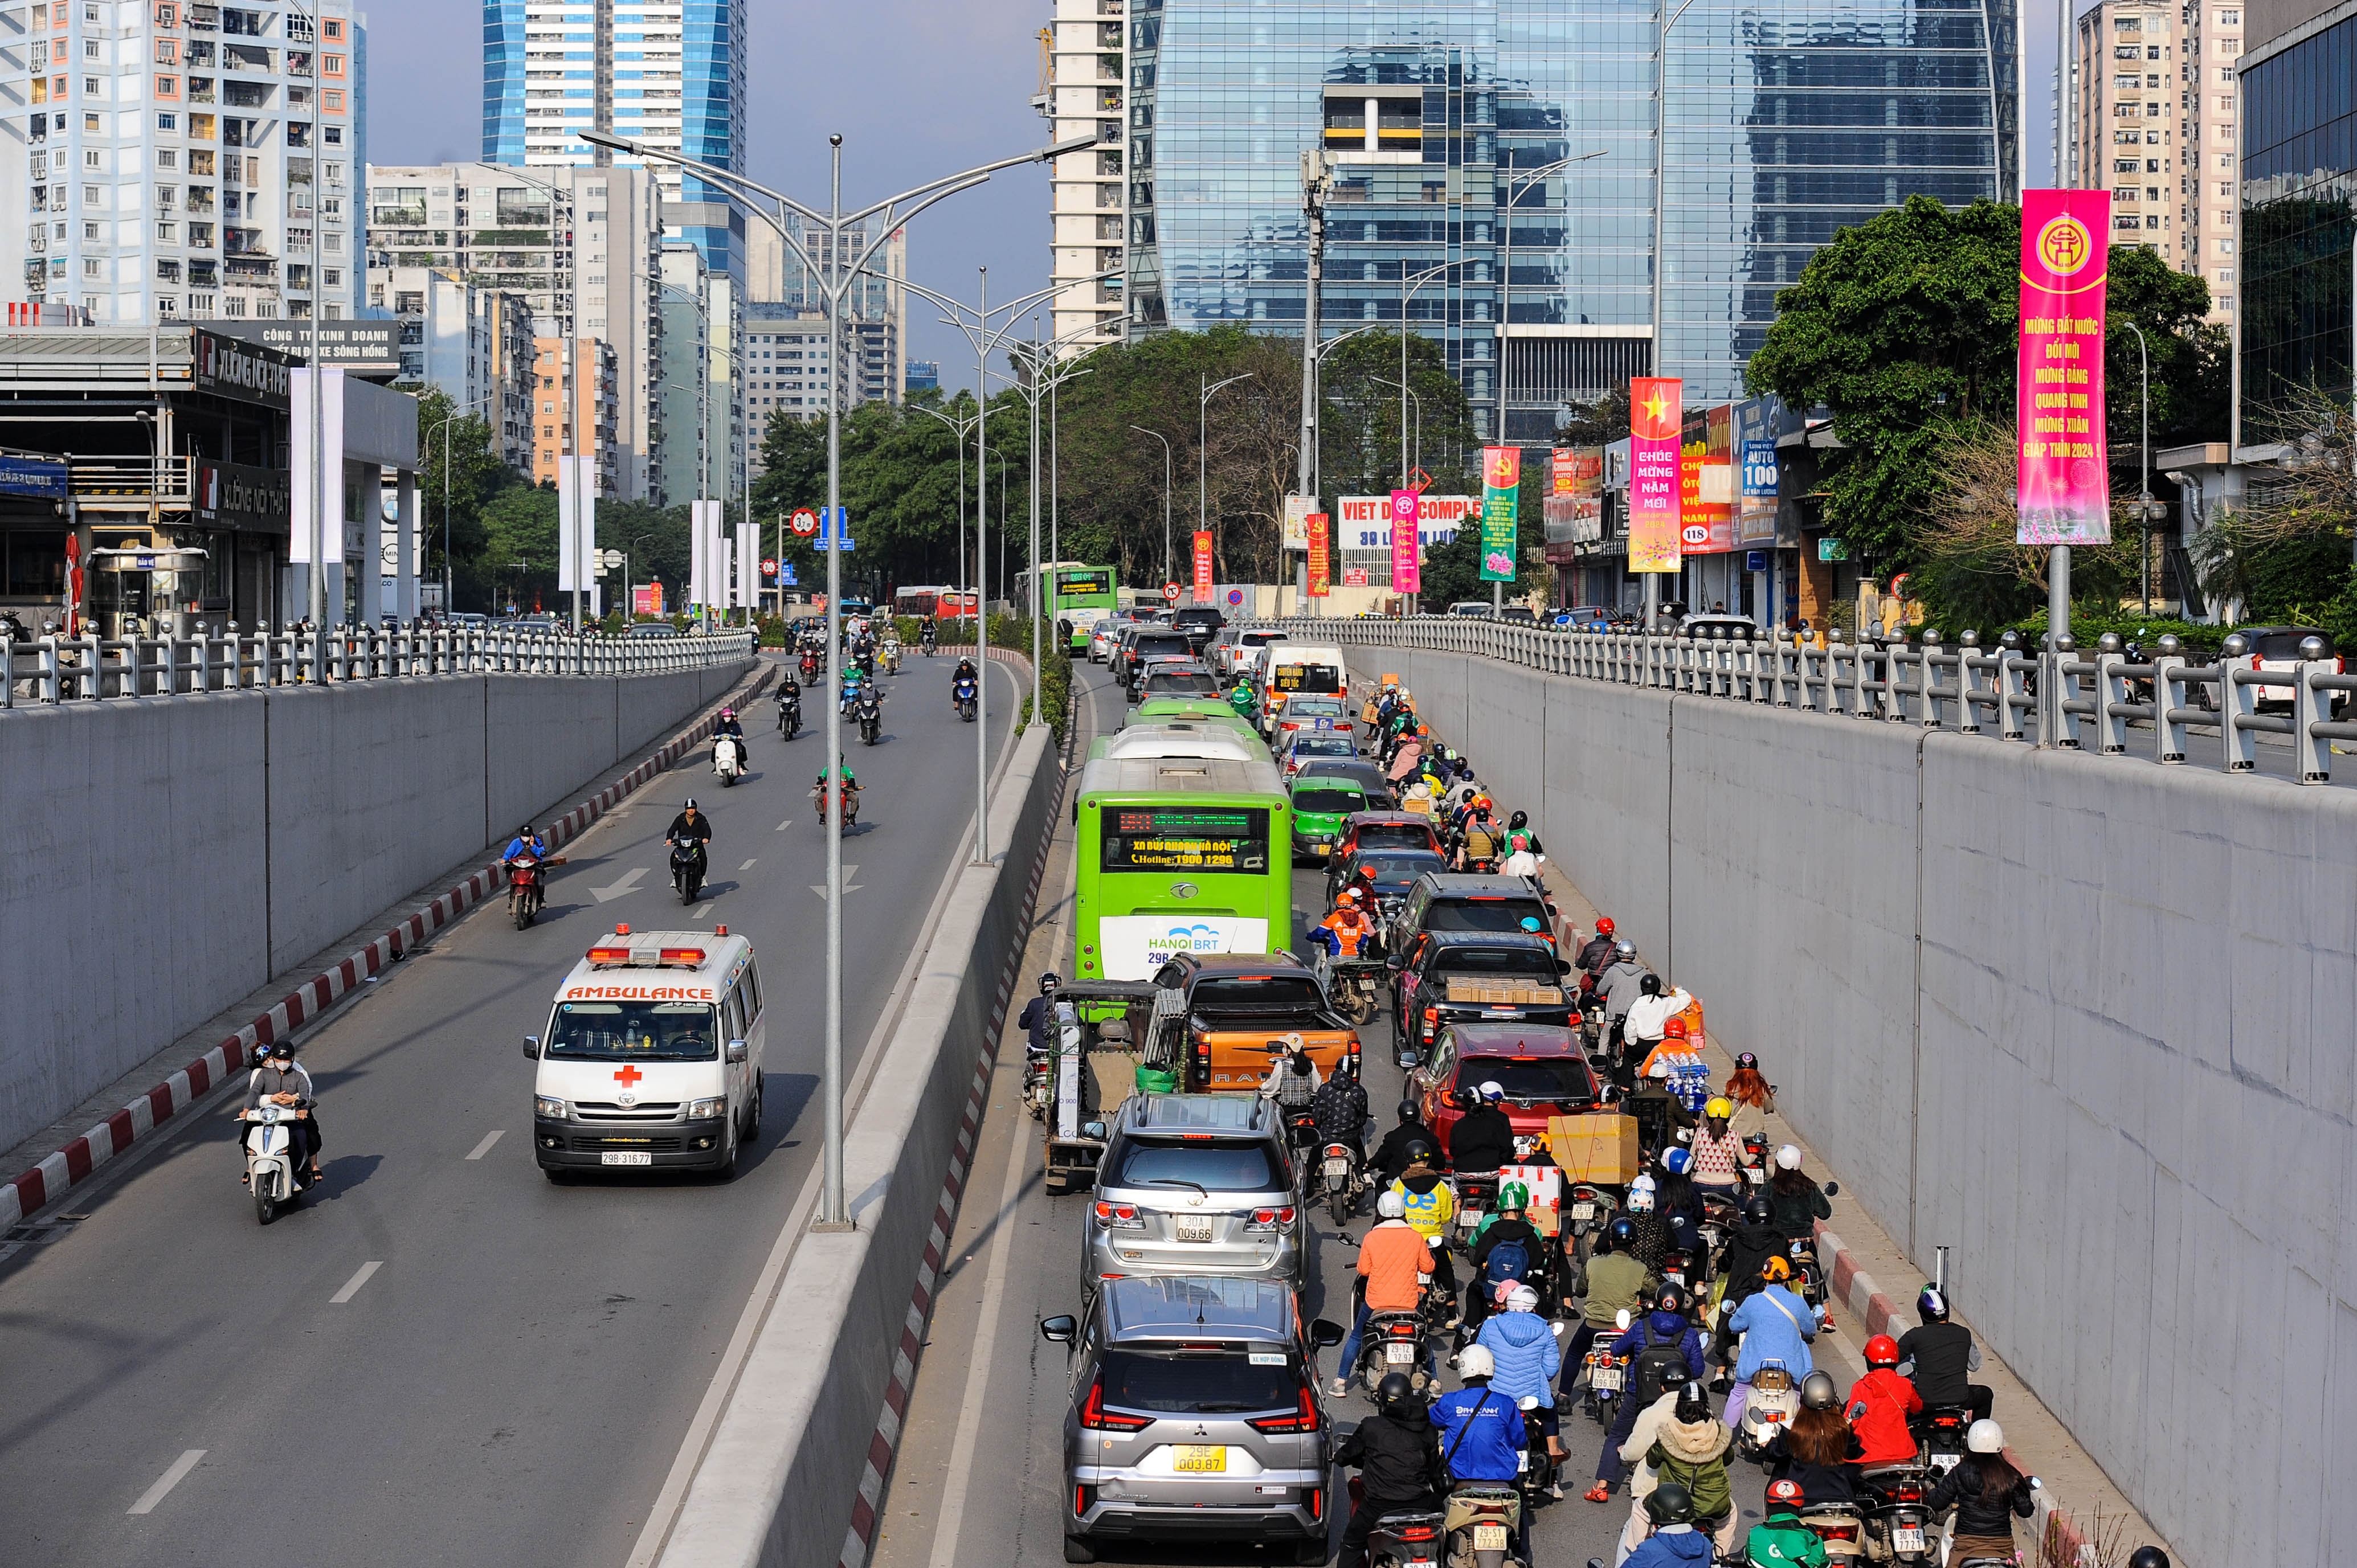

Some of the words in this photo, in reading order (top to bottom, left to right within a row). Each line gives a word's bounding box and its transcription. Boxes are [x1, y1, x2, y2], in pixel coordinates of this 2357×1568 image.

[2025, 316, 2054, 334] MỪNG
[2057, 313, 2073, 334] ĐẤT
[2074, 317, 2098, 335] NƯỚC
[263, 328, 292, 341] CÔNG
[299, 330, 312, 341] TY
[319, 330, 345, 341] KINH
[352, 330, 388, 341] DOANH
[303, 346, 312, 357] Đ
[320, 346, 330, 357] XE
[333, 345, 360, 357] SÔNG
[362, 343, 388, 357] HỒNG
[2046, 337, 2062, 359] ĐỔI
[2065, 340, 2080, 359] MỚI
[2035, 365, 2064, 384] MỪNG
[2067, 364, 2088, 384] ĐẢNG
[2035, 393, 2068, 410] QUANG
[2069, 393, 2088, 408] VINH
[2035, 415, 2064, 433] MỪNG
[2066, 415, 2089, 433] XUÂN
[2023, 440, 2047, 458] GIÁP
[2049, 439, 2070, 458] THÌN
[2072, 443, 2094, 458] 2024
[1639, 450, 1673, 462] CHÚC
[1747, 451, 1774, 463] AUTO
[1554, 462, 1572, 472] CHUNG
[1637, 465, 1673, 477] MỪNG
[1745, 465, 1777, 485] 100
[1641, 481, 1669, 493] NĂM
[1644, 496, 1666, 508] MỚI
[1682, 495, 1704, 507] VIỆ
[1343, 502, 1376, 520] VIET
[1418, 501, 1481, 519] COMPLE
[1682, 514, 1707, 522] NAM
[1686, 530, 1704, 539] 118
[138, 558, 147, 566] BẢO
[1146, 841, 1164, 850] BUS
[1175, 855, 1203, 864] 1900
[1206, 855, 1232, 864] 1296
[1194, 940, 1218, 949] BRT
[567, 986, 713, 1000] AMBULANCE
[604, 1154, 649, 1164] 29B-316.77
[1186, 1217, 1203, 1227] 30A
[1178, 1228, 1211, 1239] 009.66
[1598, 1370, 1616, 1378] 29-AA
[1189, 1447, 1210, 1458] 29E
[1179, 1459, 1220, 1470] 003.87
[1480, 1528, 1501, 1537] 29-S1
[1899, 1530, 1919, 1540] 30-Y2
[1477, 1538, 1504, 1548] 772.38
[1900, 1540, 1921, 1550] 7721
